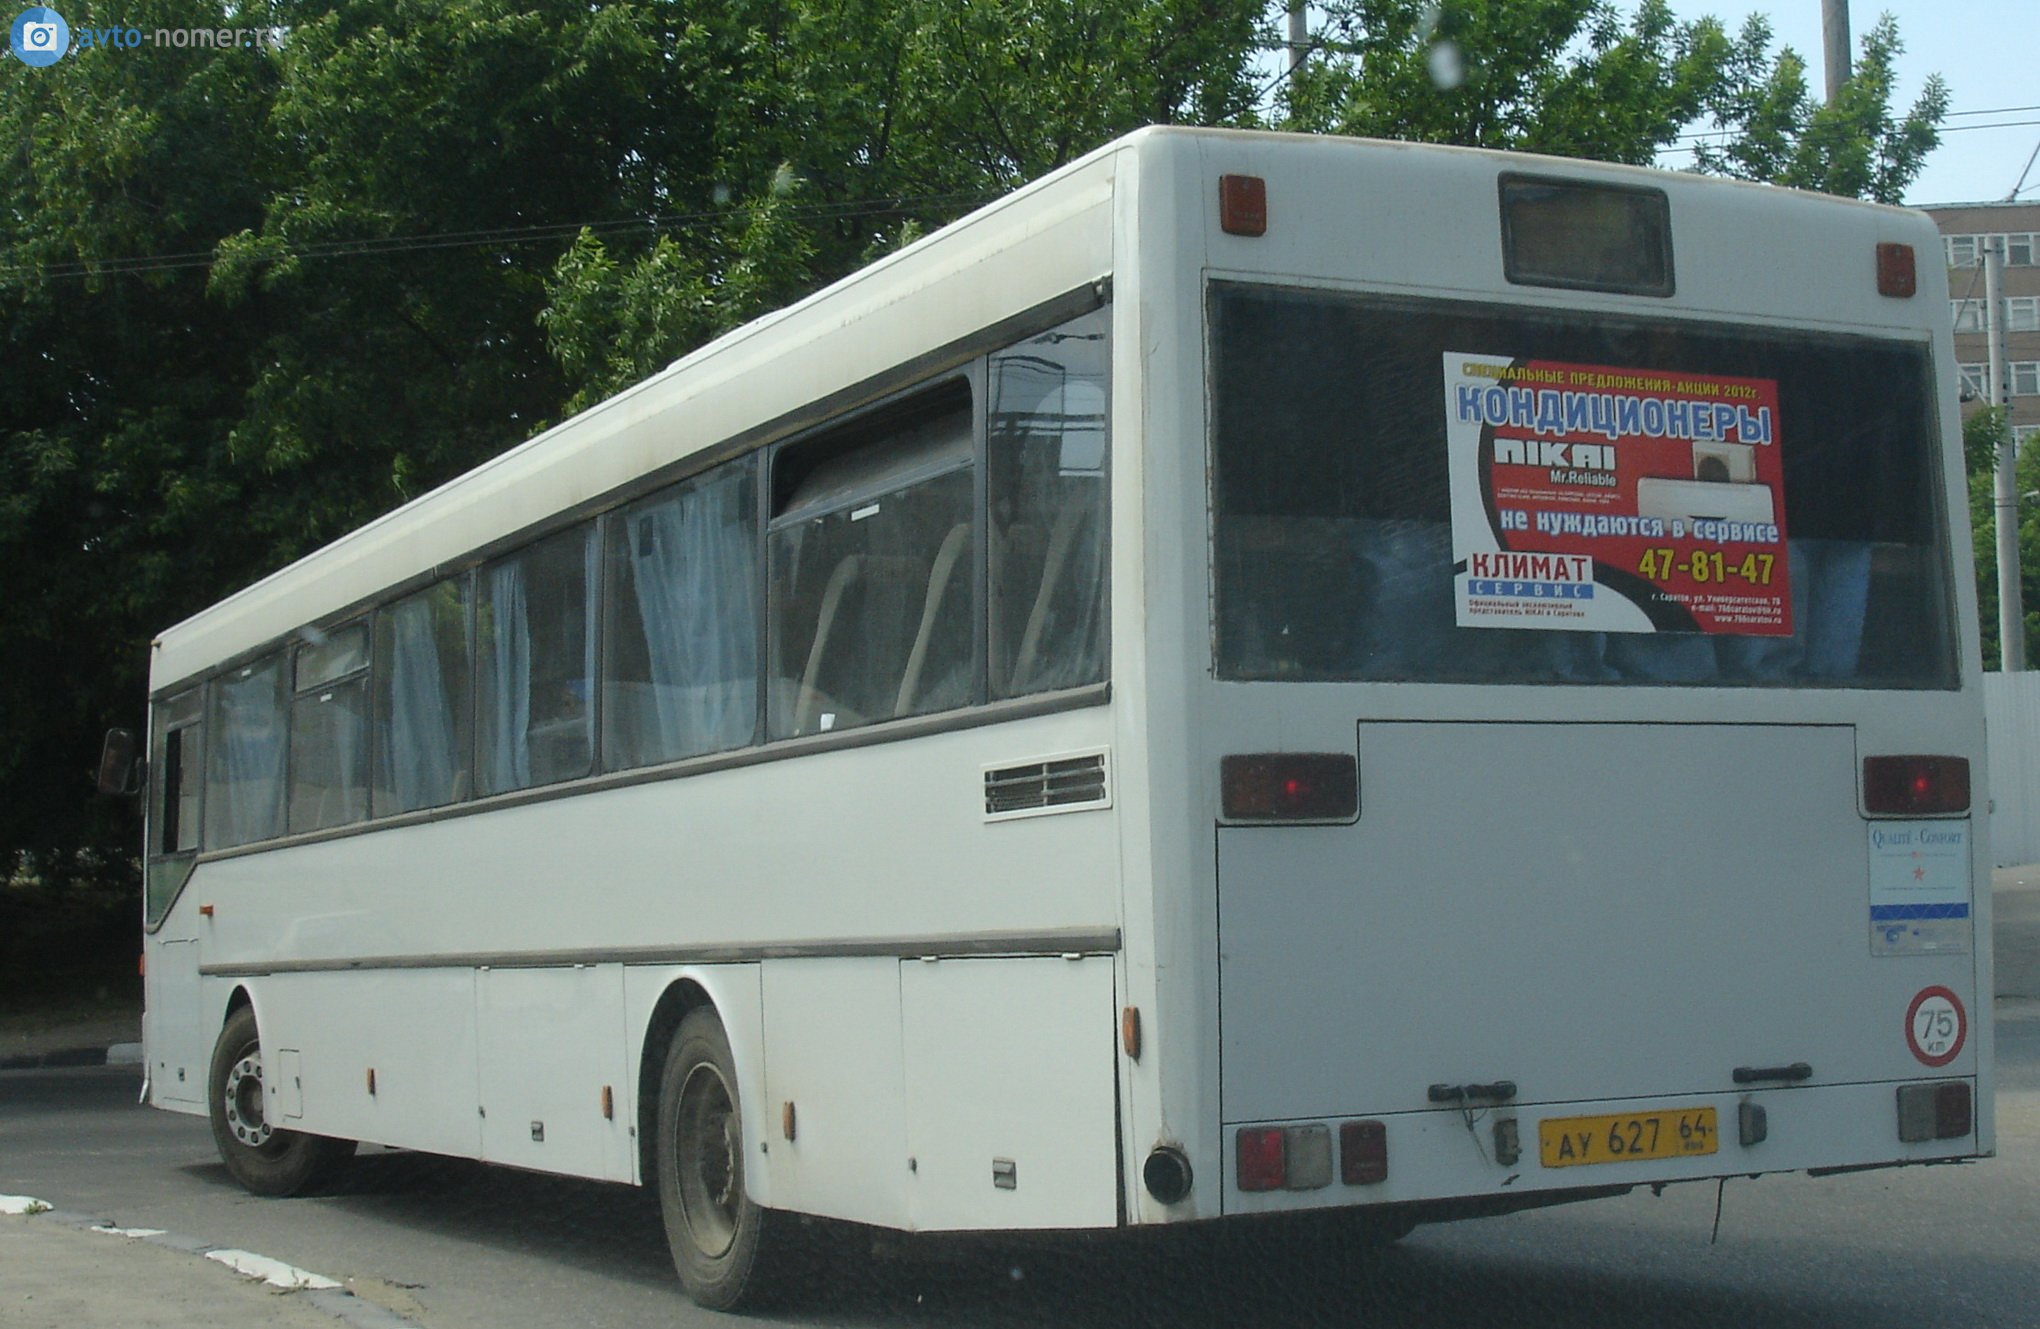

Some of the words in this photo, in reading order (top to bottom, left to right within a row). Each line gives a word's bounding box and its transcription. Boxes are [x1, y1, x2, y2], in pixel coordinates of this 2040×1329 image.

[1462, 362, 1565, 384] СПЕЦИАЛЬНЫЕ
[1456, 384, 1771, 445] КОНДИЦИОНЕРЫ
[1550, 470, 1617, 487] Mr.Reliable
[1501, 509, 1528, 531] не
[1537, 511, 1664, 537] нуждаются
[1673, 518, 1685, 538] в
[1693, 519, 1780, 543] сервисе
[1472, 553, 1587, 581] КЛИМАТ
[1639, 548, 1775, 585] 47-81-47
[1475, 581, 1583, 597] СЕРВИС
[1921, 1010, 1953, 1039] 75
[1608, 1118, 1660, 1154] 627
[1679, 1113, 1706, 1139] 64
